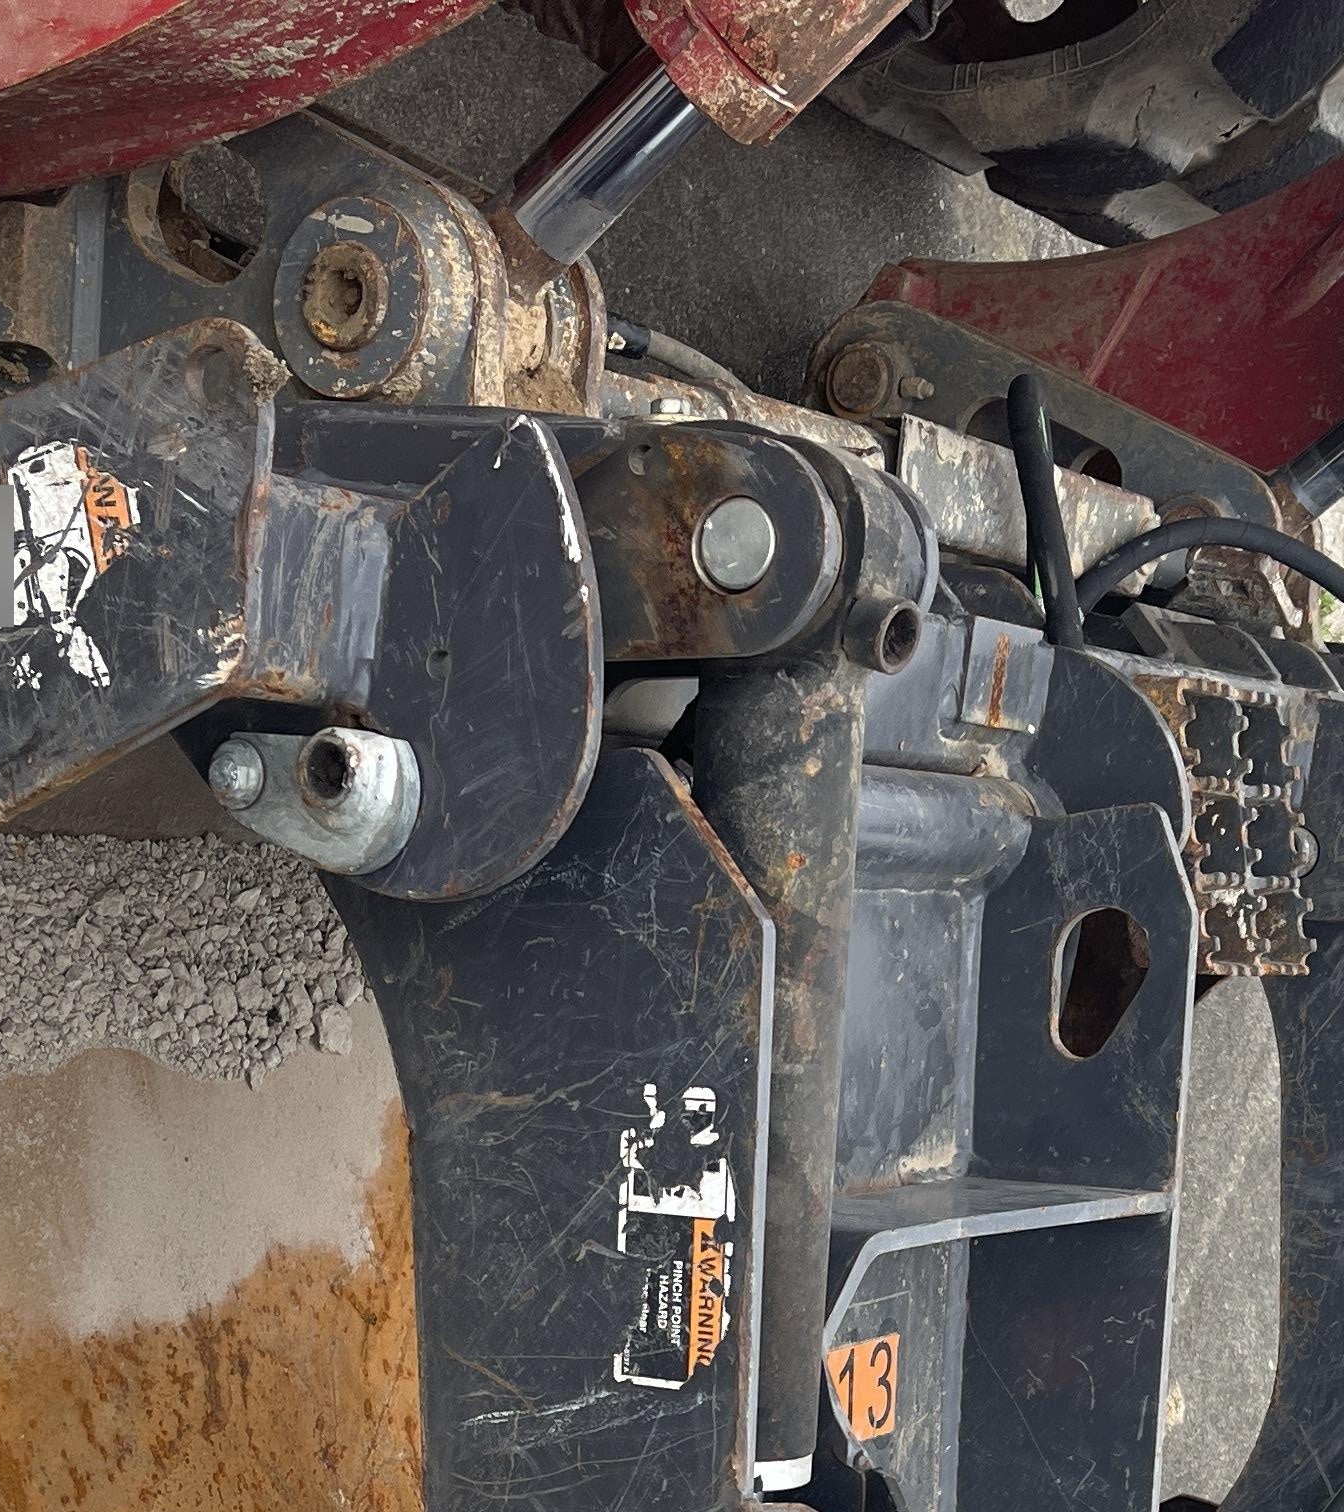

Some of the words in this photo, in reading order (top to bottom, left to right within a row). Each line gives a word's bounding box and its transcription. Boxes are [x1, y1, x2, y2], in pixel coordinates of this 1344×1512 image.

[657, 1274, 669, 1330] HAZARD
[672, 1260, 684, 1303] PINCH
[670, 1305, 682, 1347] POINT
[839, 1340, 892, 1429] 13
